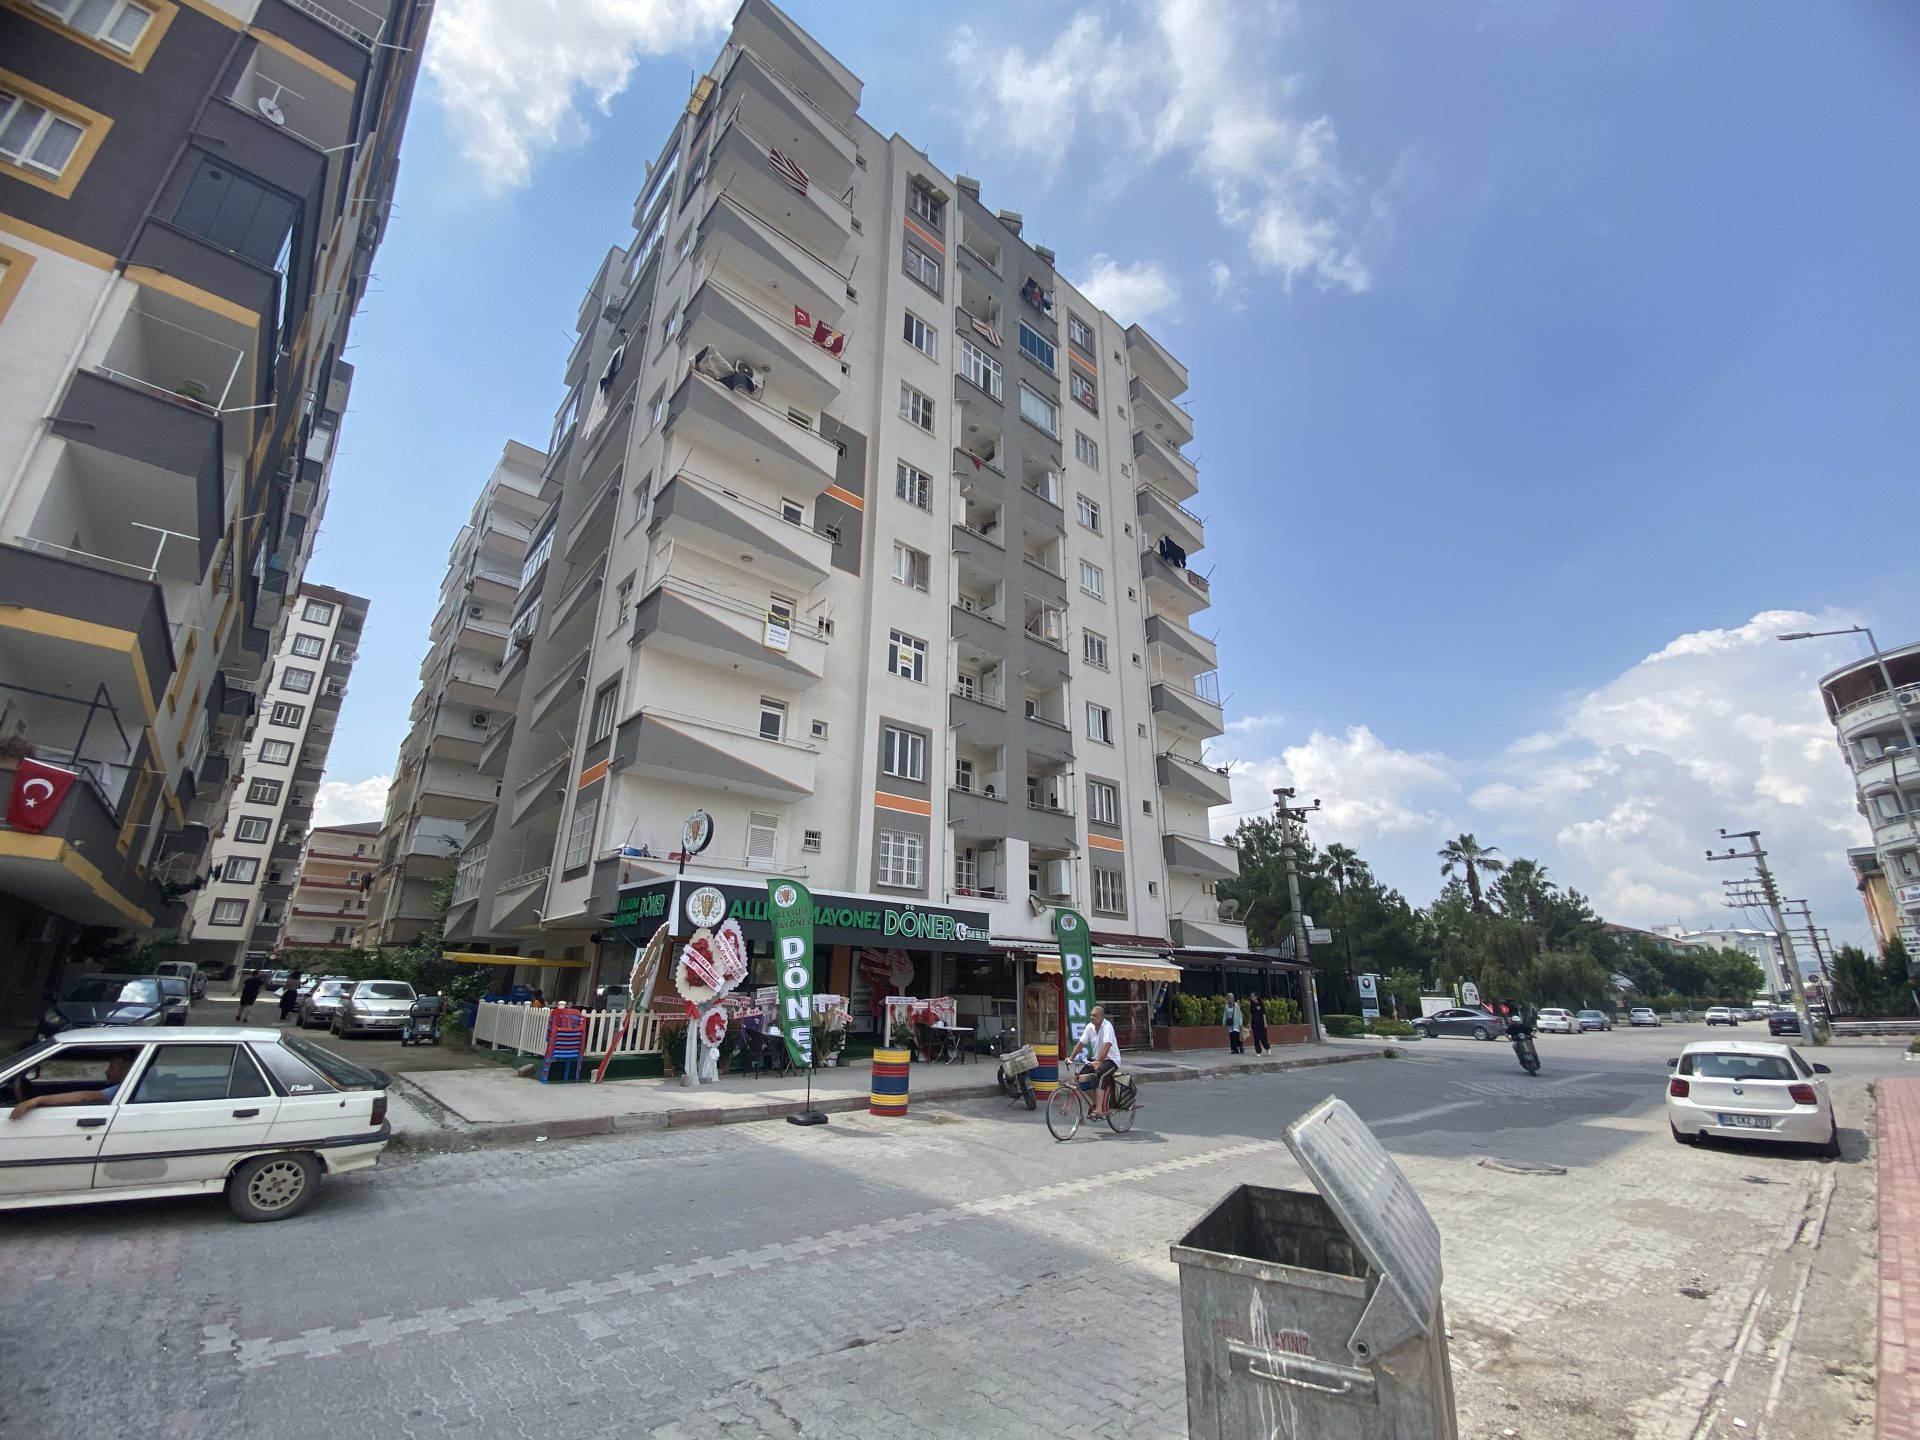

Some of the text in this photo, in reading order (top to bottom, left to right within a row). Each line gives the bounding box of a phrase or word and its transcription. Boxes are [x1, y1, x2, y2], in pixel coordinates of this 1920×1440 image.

[639, 890, 665, 918] DÖNER
[729, 899, 769, 920] ALLI
[777, 907, 808, 918] ALLIUM
[884, 904, 956, 941] DÖNER
[290, 1083, 314, 1092] Flash
